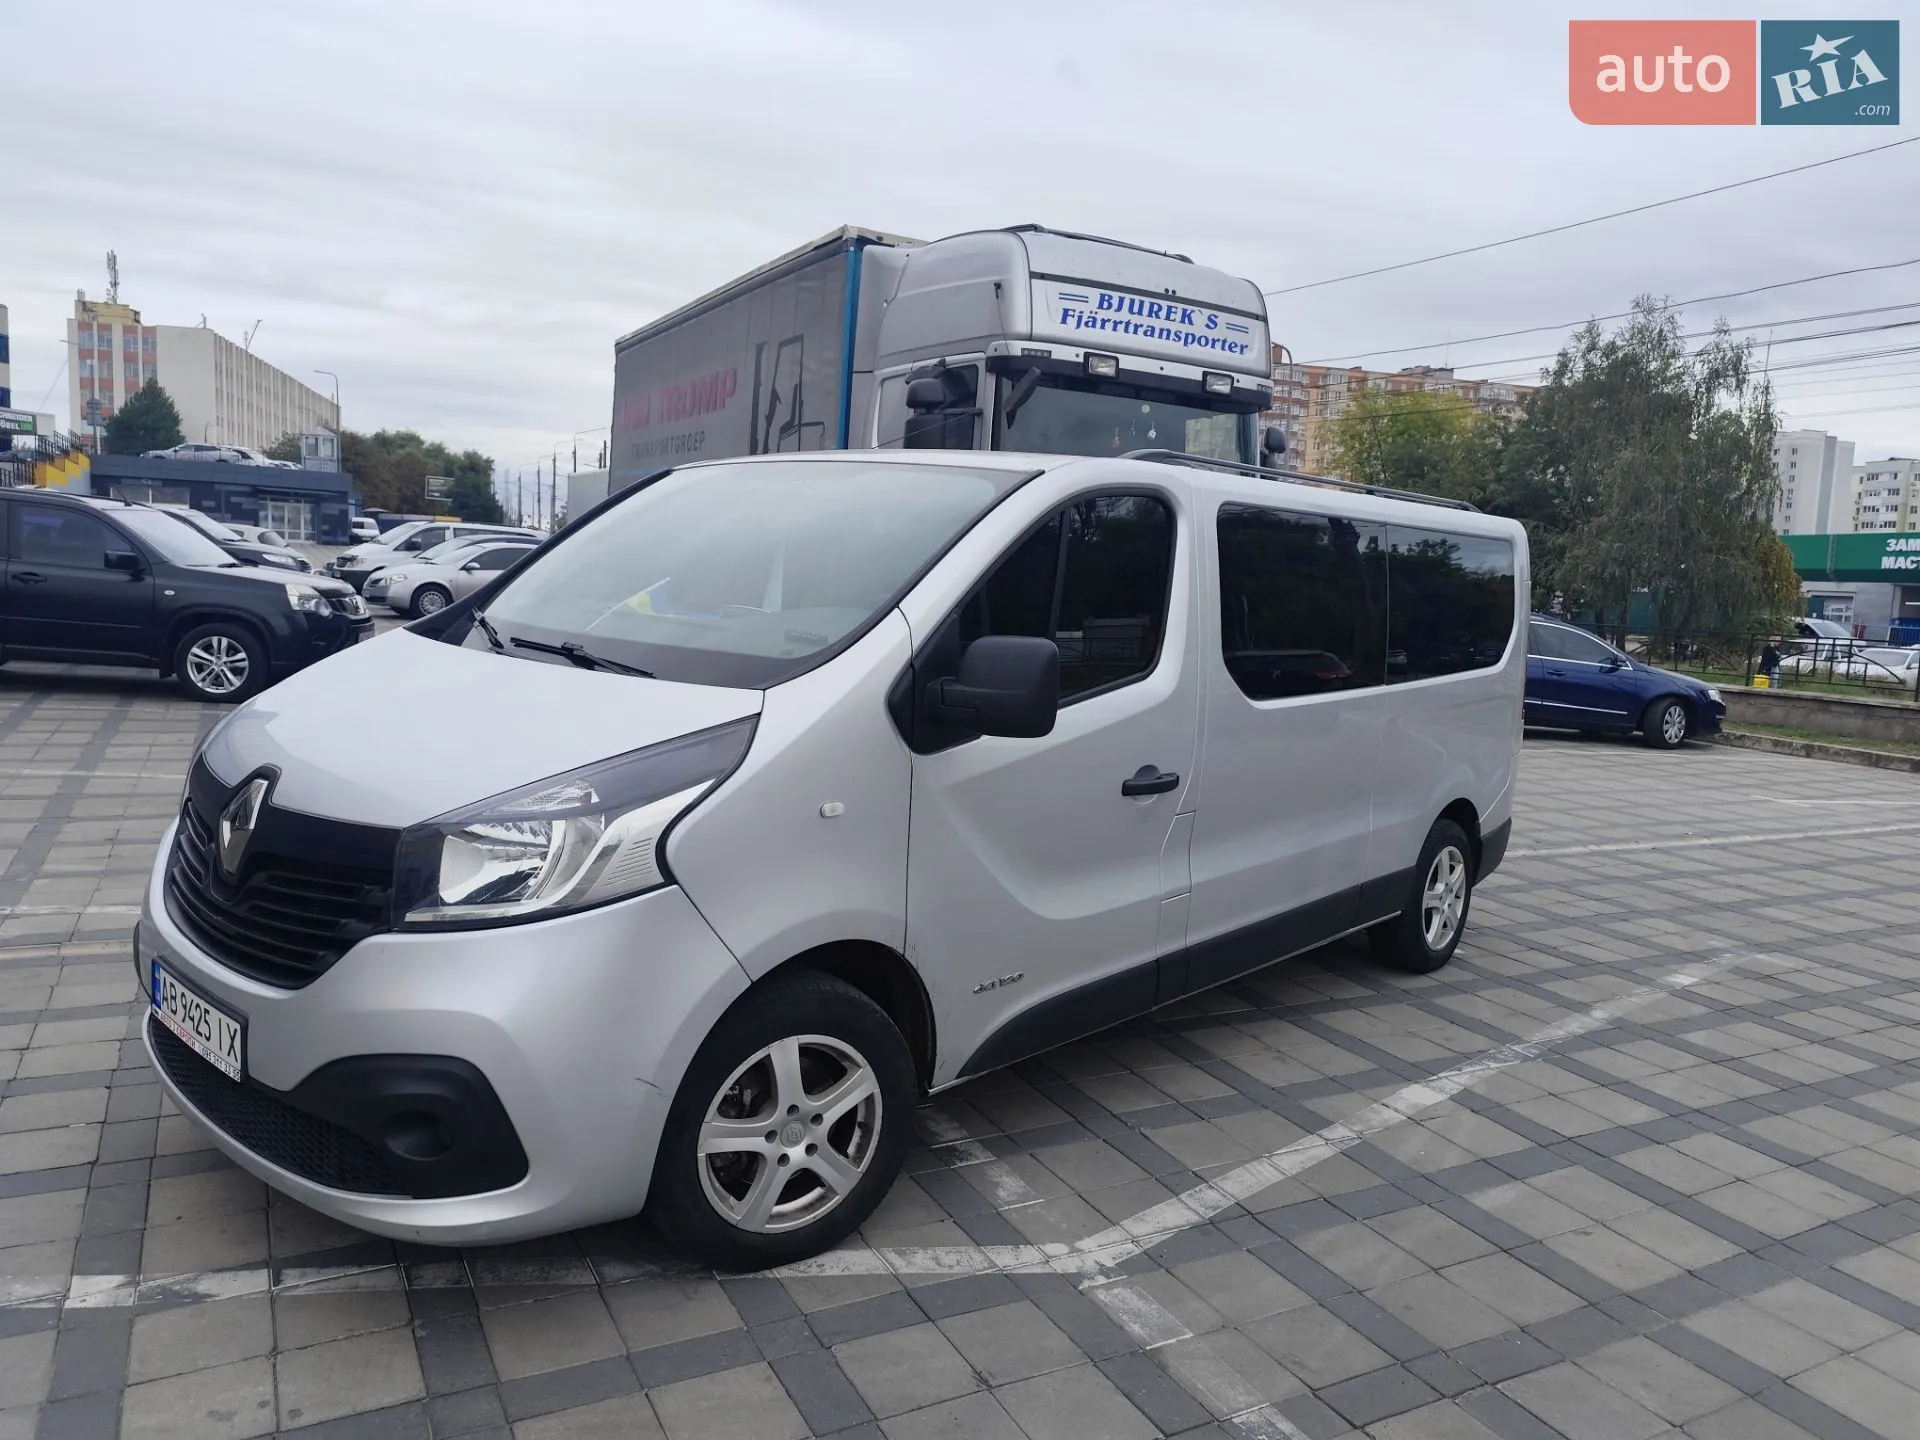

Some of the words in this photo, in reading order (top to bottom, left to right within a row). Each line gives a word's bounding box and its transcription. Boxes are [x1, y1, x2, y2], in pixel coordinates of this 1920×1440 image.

[1059, 307, 1249, 356] Fjärrtransporter
[1881, 556, 1920, 569] МАС
[180, 991, 212, 1042] 9425
